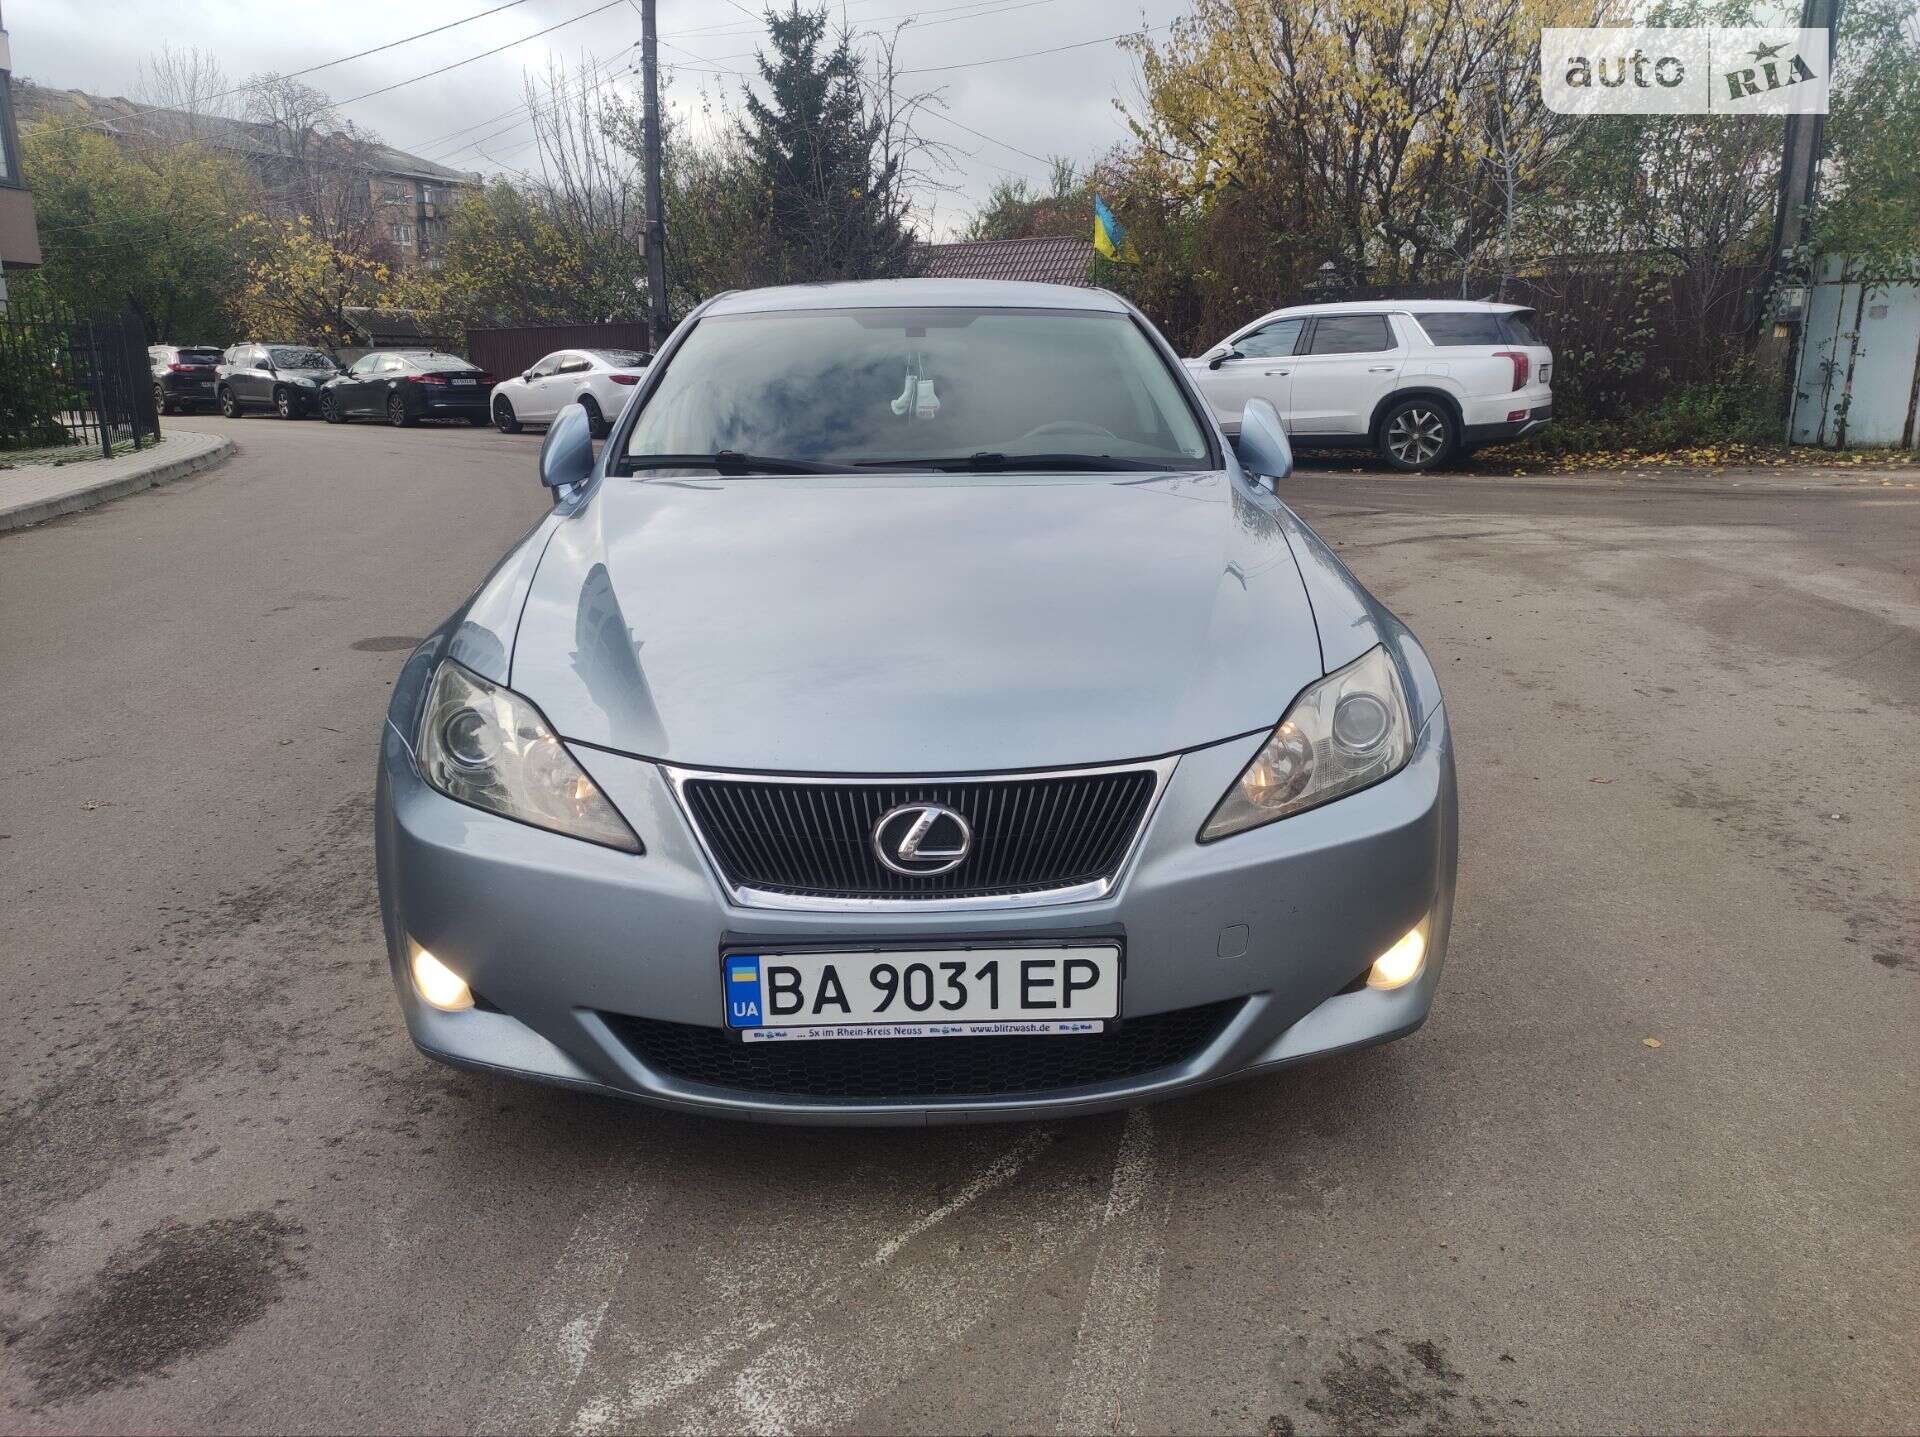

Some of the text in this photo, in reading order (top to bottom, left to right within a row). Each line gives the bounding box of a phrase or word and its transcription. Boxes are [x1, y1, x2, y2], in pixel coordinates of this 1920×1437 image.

[767, 959, 1101, 1015] BA 9031 EP
[734, 1002, 759, 1017] UA
[822, 1029, 834, 1037] im
[837, 1027, 891, 1037] Rhein-Kreis
[893, 1026, 923, 1036] Neuss
[970, 1023, 1051, 1033] www.blitzwash.de
